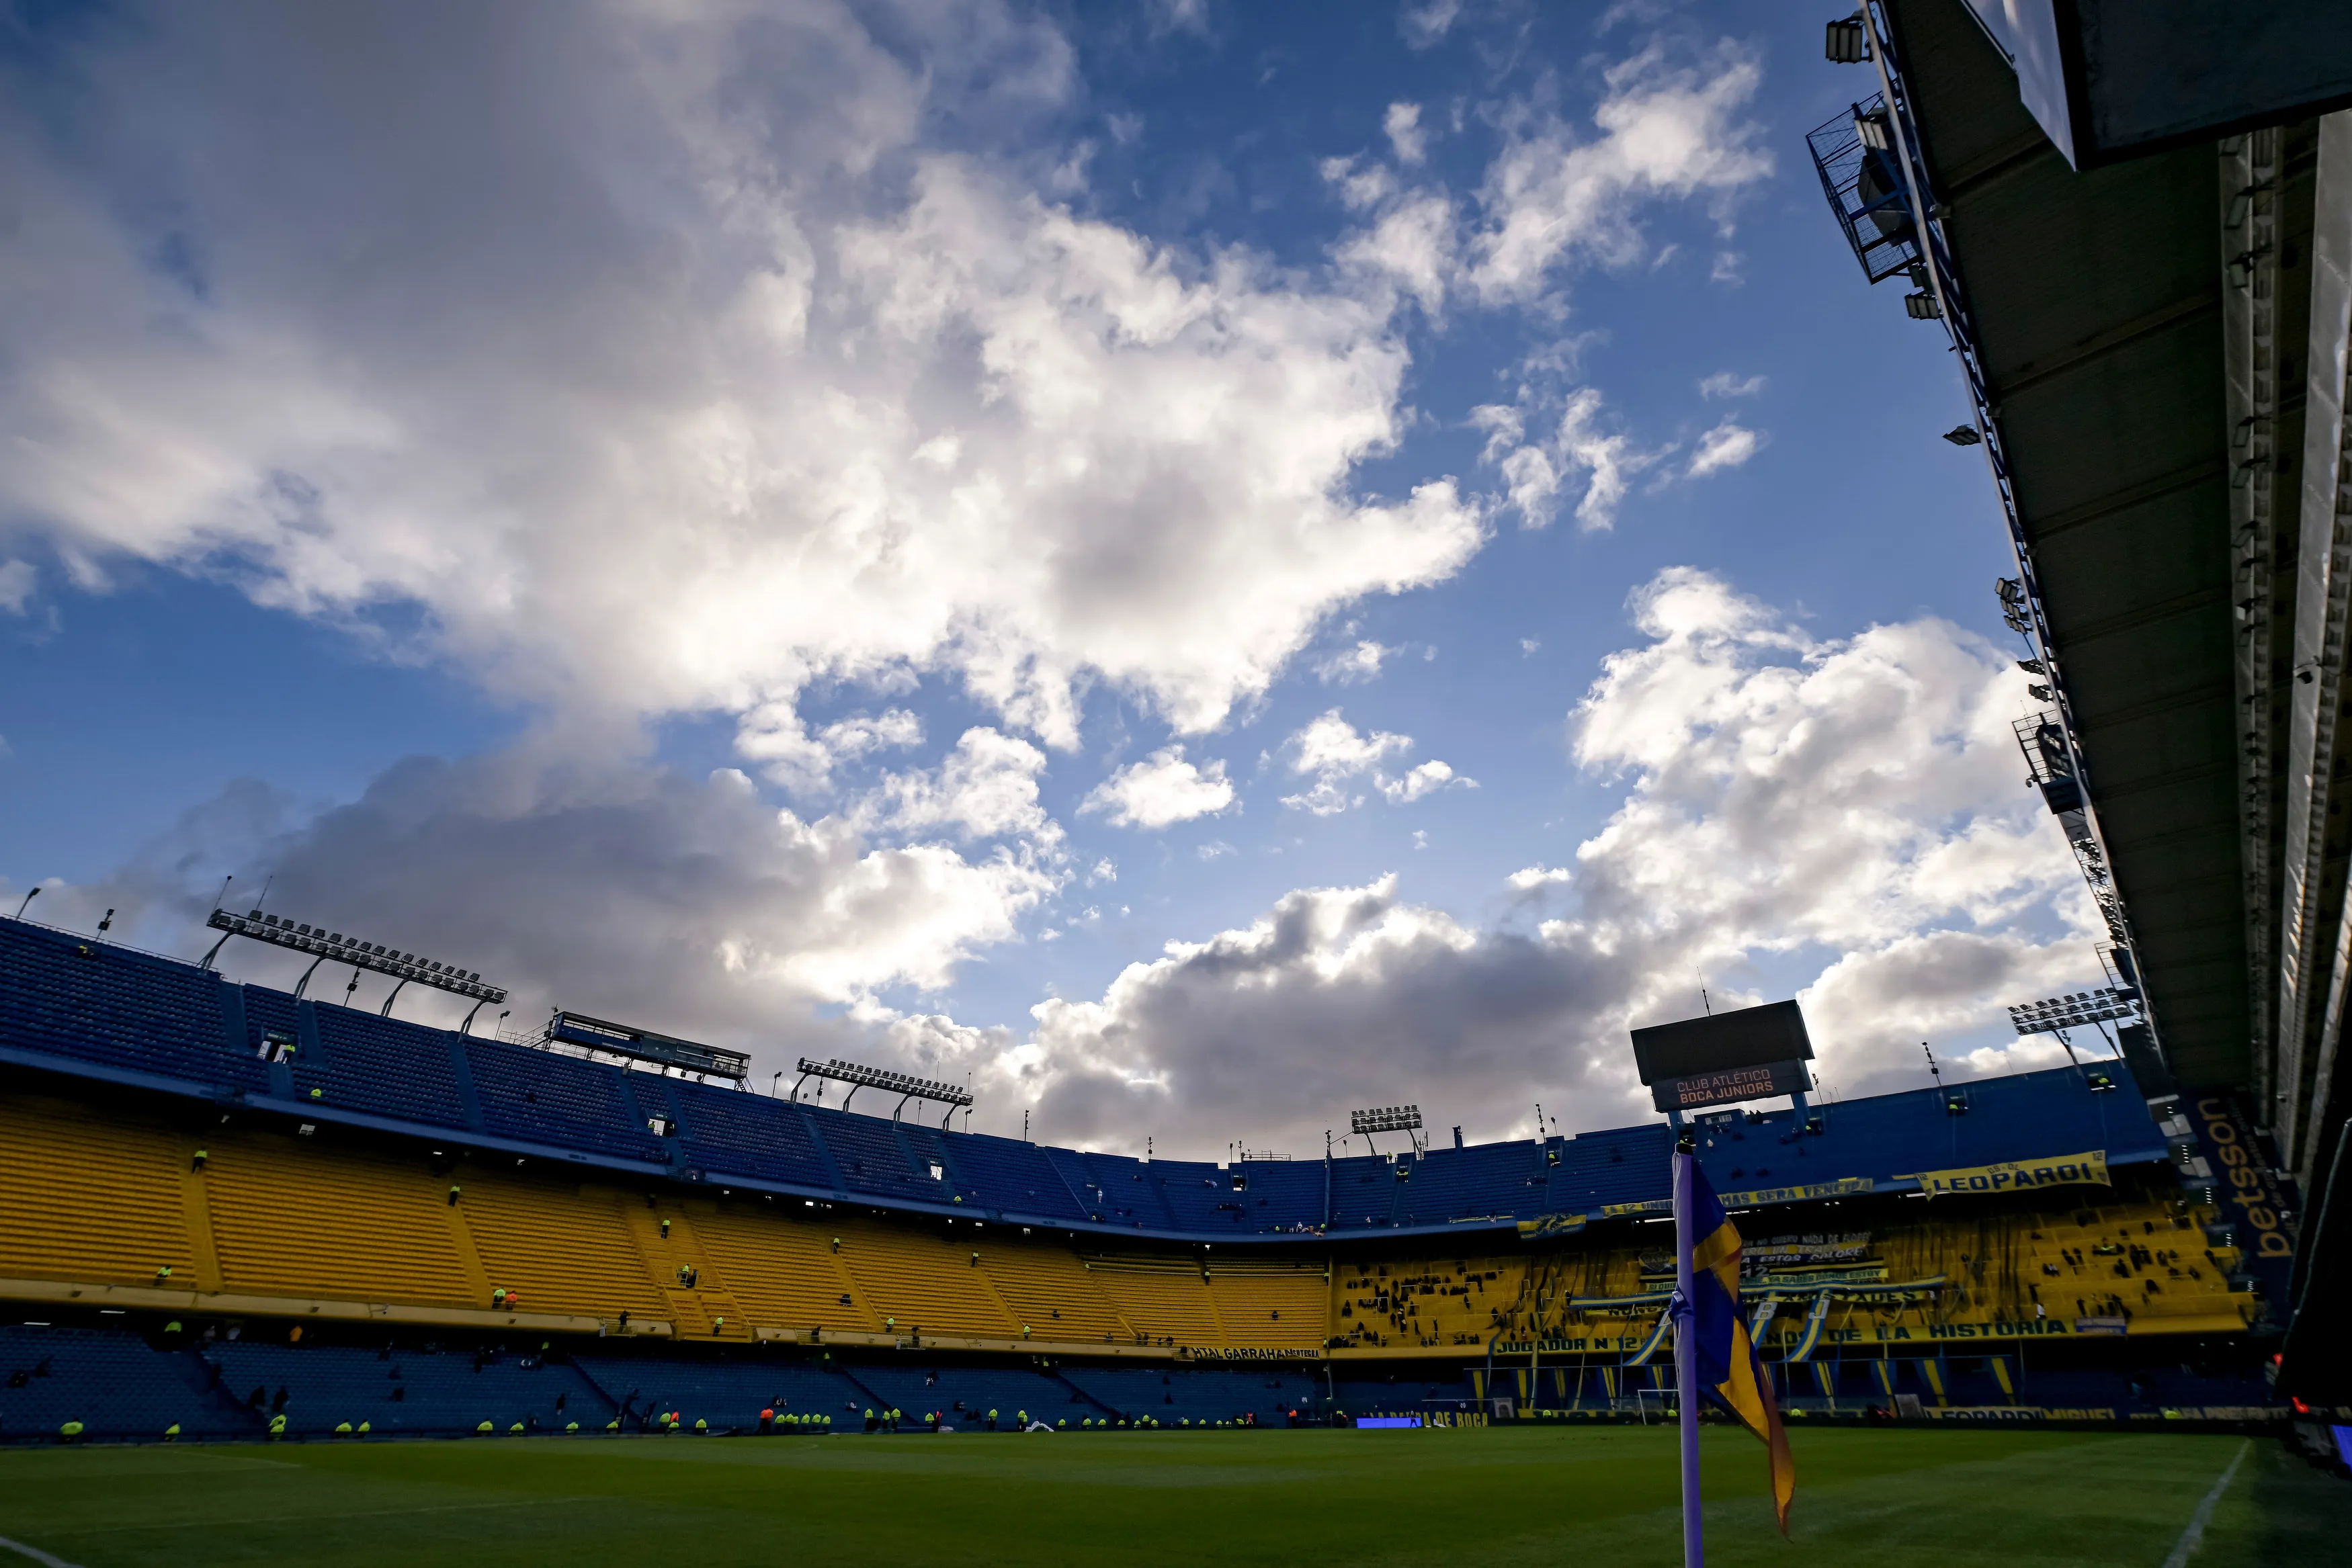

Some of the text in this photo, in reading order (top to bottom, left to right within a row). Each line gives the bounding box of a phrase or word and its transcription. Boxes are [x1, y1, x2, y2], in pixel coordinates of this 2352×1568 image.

[1677, 1069, 1771, 1092] CLUB ATLÉTICO
[1680, 1080, 1774, 1104] BOCA JUNIORS
[1933, 1163, 2094, 1191] LEOPARDI
[2195, 1097, 2293, 1258] betsson
[1496, 1338, 1587, 1354] JUGADOR
[1929, 1319, 2068, 1338] HISTORIA
[1456, 1411, 1488, 1428] BOCA
